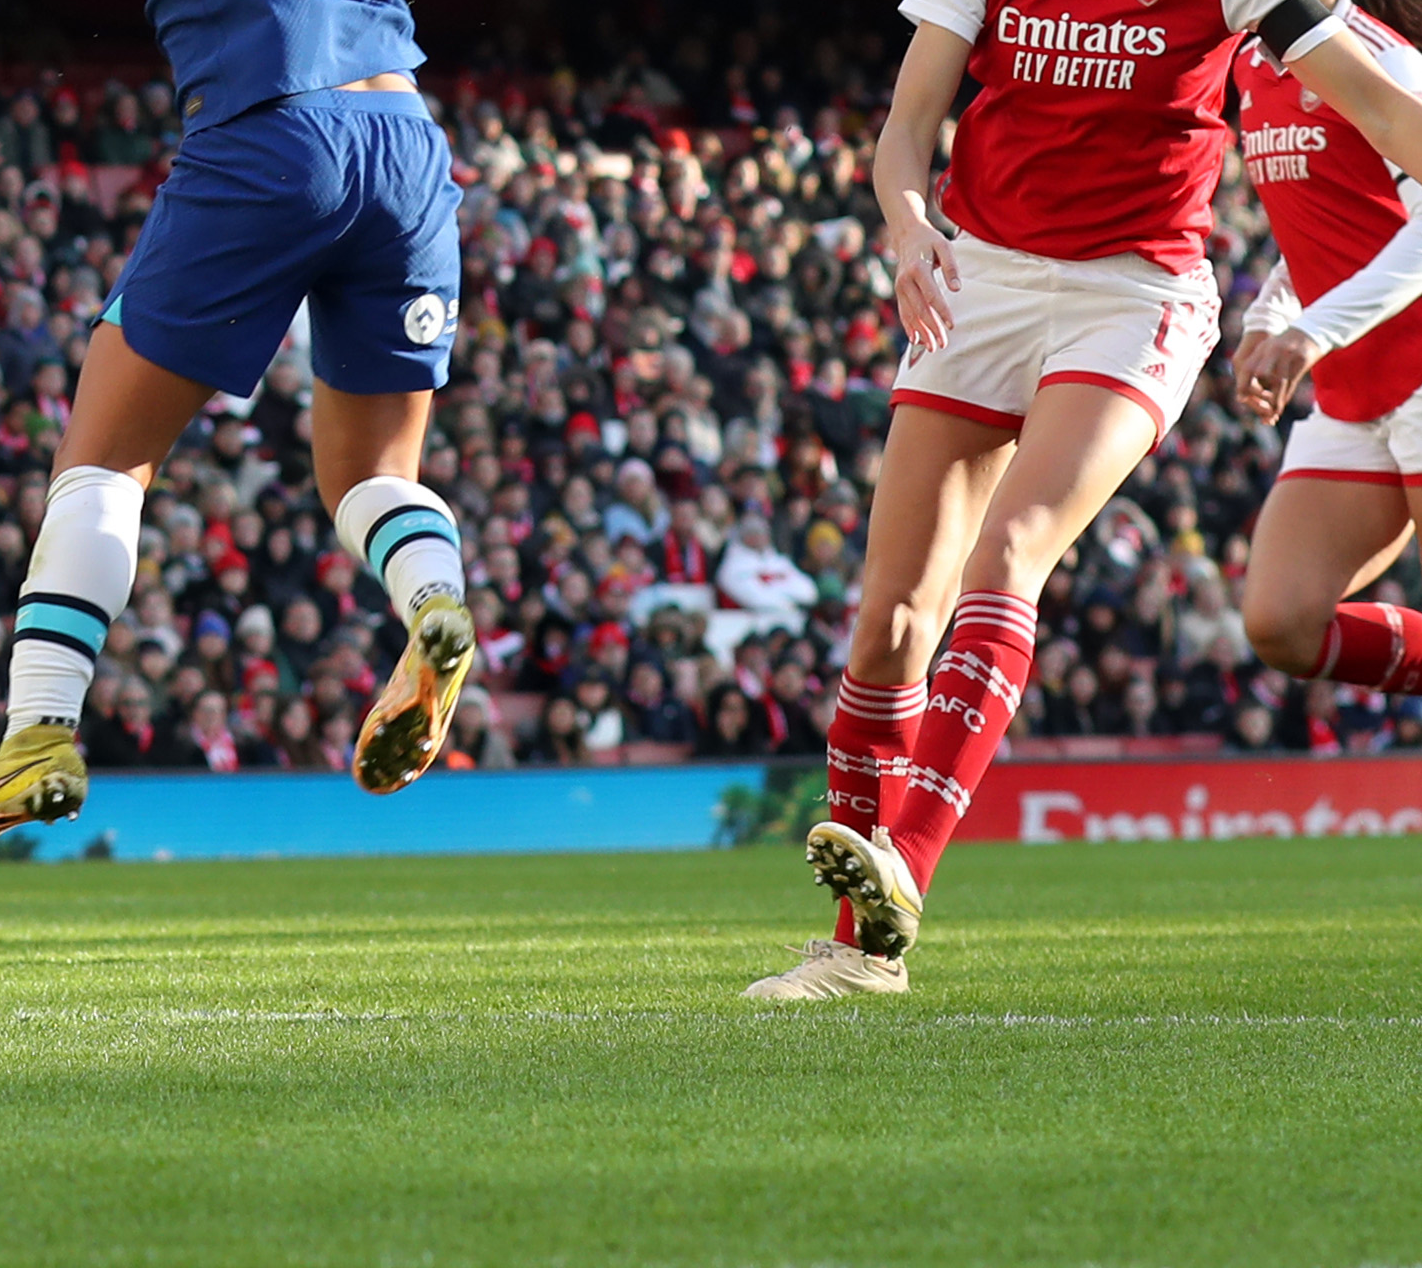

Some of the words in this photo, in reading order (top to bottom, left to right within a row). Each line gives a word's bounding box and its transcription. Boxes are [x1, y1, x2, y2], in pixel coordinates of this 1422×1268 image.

[997, 6, 1166, 56] Emirates
[1013, 51, 1048, 82] FLY
[1052, 56, 1136, 90] BETTER
[928, 693, 987, 734] AFC
[826, 789, 877, 814] AFC
